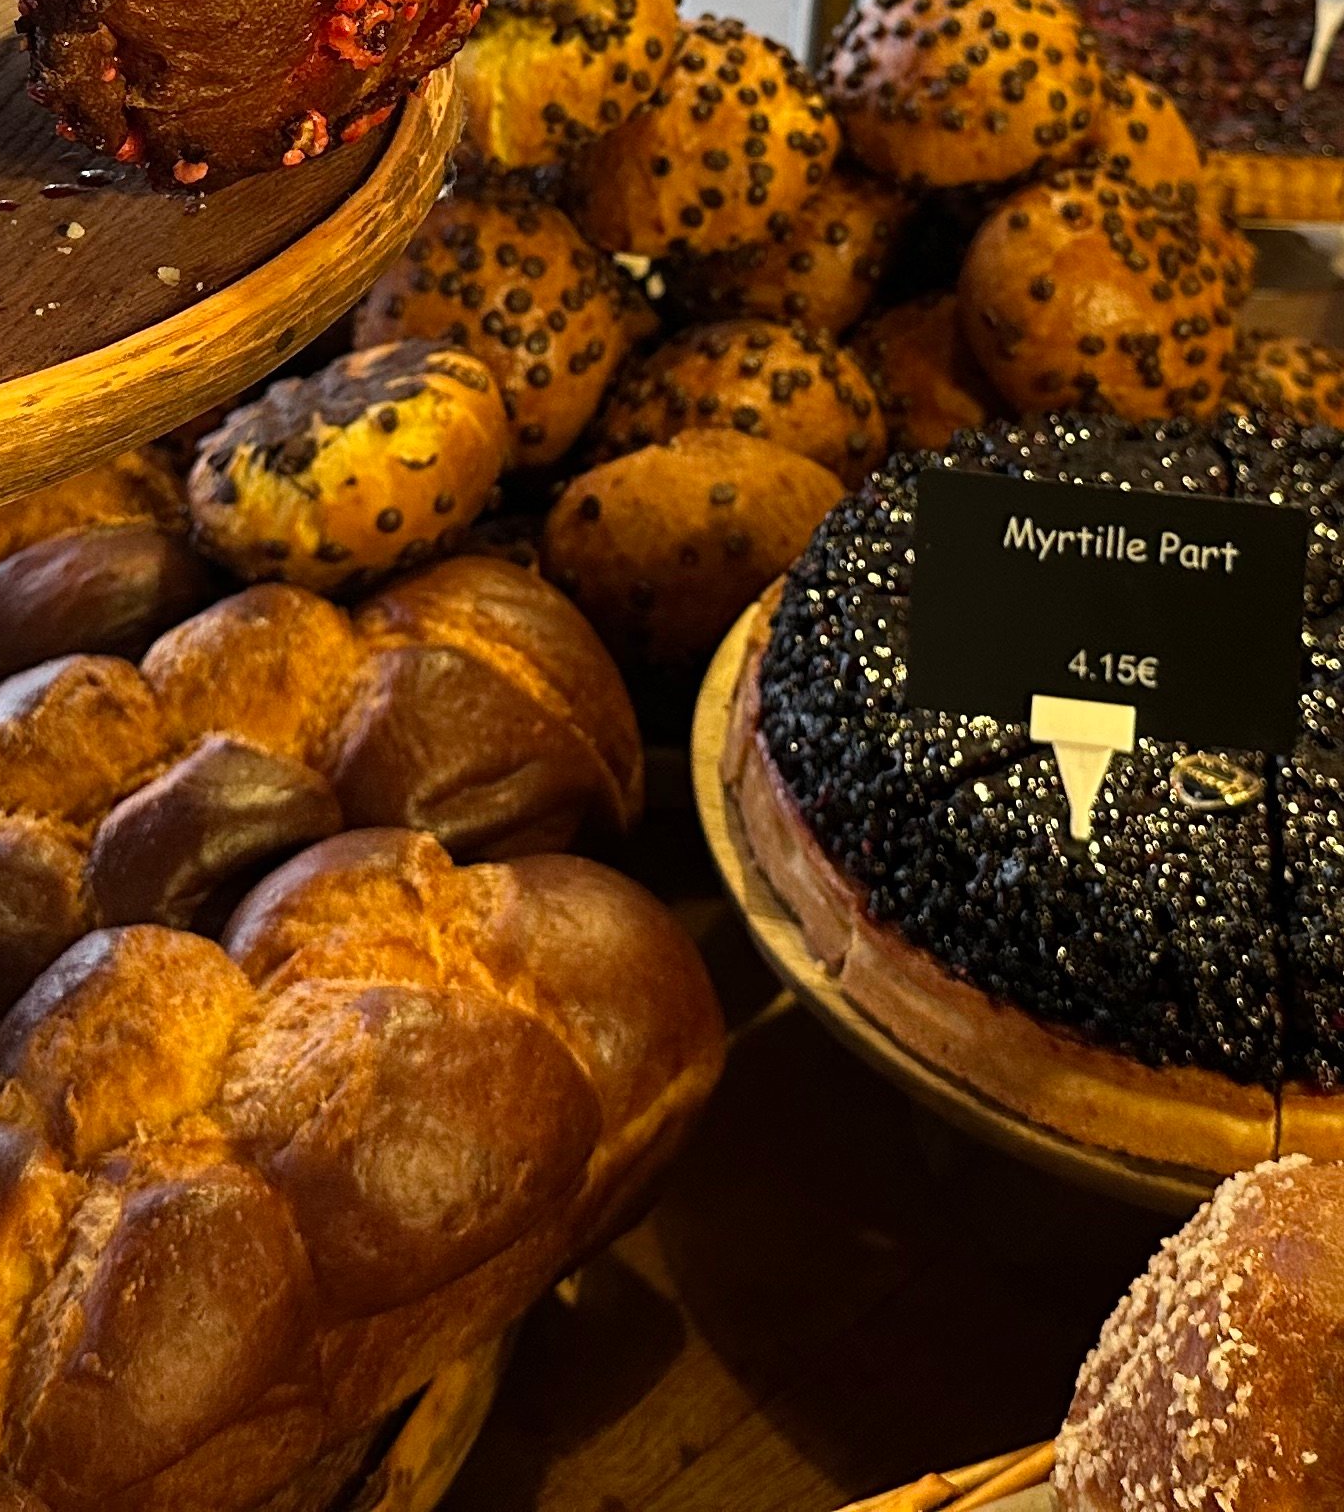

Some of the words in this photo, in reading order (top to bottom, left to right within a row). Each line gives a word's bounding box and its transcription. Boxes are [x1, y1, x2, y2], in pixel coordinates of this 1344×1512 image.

[1002, 514, 1149, 563] Myrtille
[1159, 530, 1240, 575] Part
[1067, 648, 1160, 689] 4.15€
